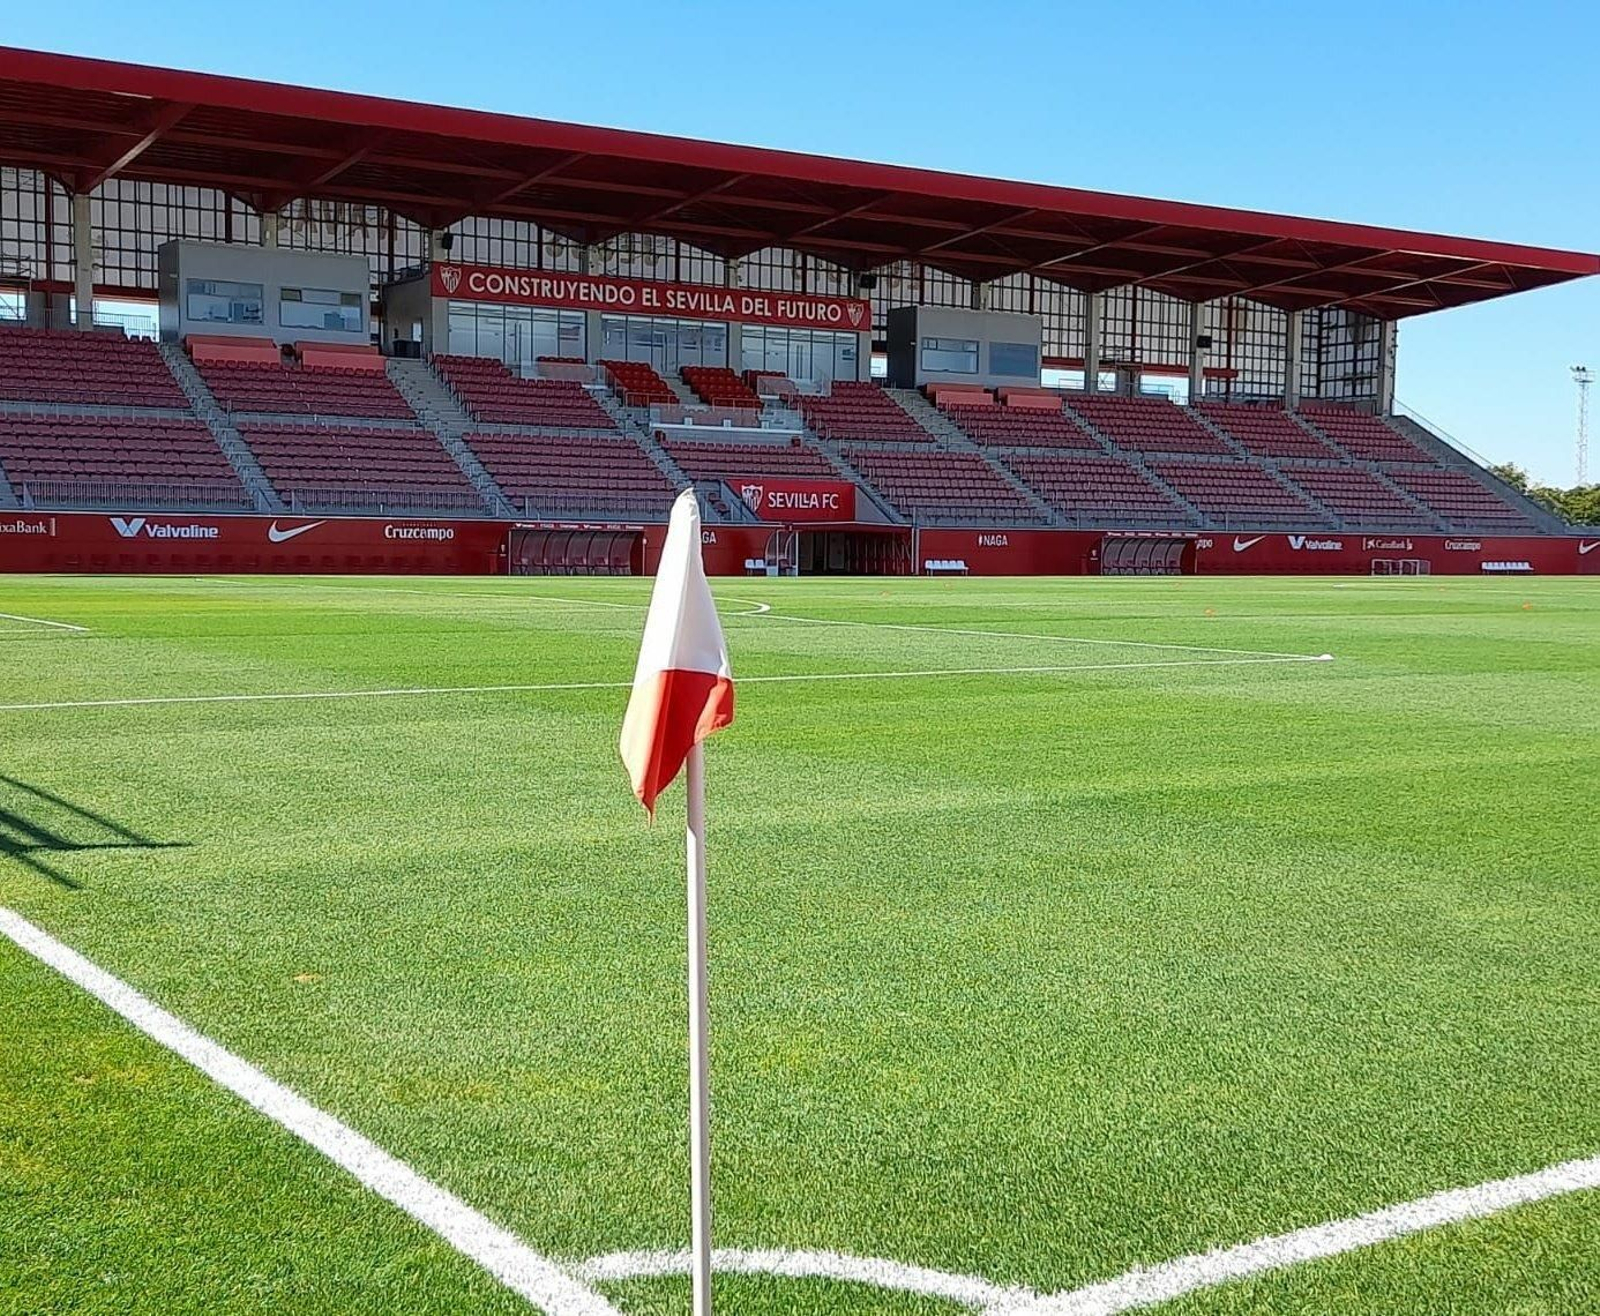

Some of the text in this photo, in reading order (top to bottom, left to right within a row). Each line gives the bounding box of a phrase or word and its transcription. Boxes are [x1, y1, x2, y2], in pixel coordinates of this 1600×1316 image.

[469, 272, 841, 322] CONSTRUYENDO EL SEVILLA DEL FUTURO
[768, 492, 839, 509] SEVILLA FC
[146, 524, 219, 538] Valvoline
[384, 524, 454, 541] Cruzcampo
[983, 535, 1008, 546] NAGA
